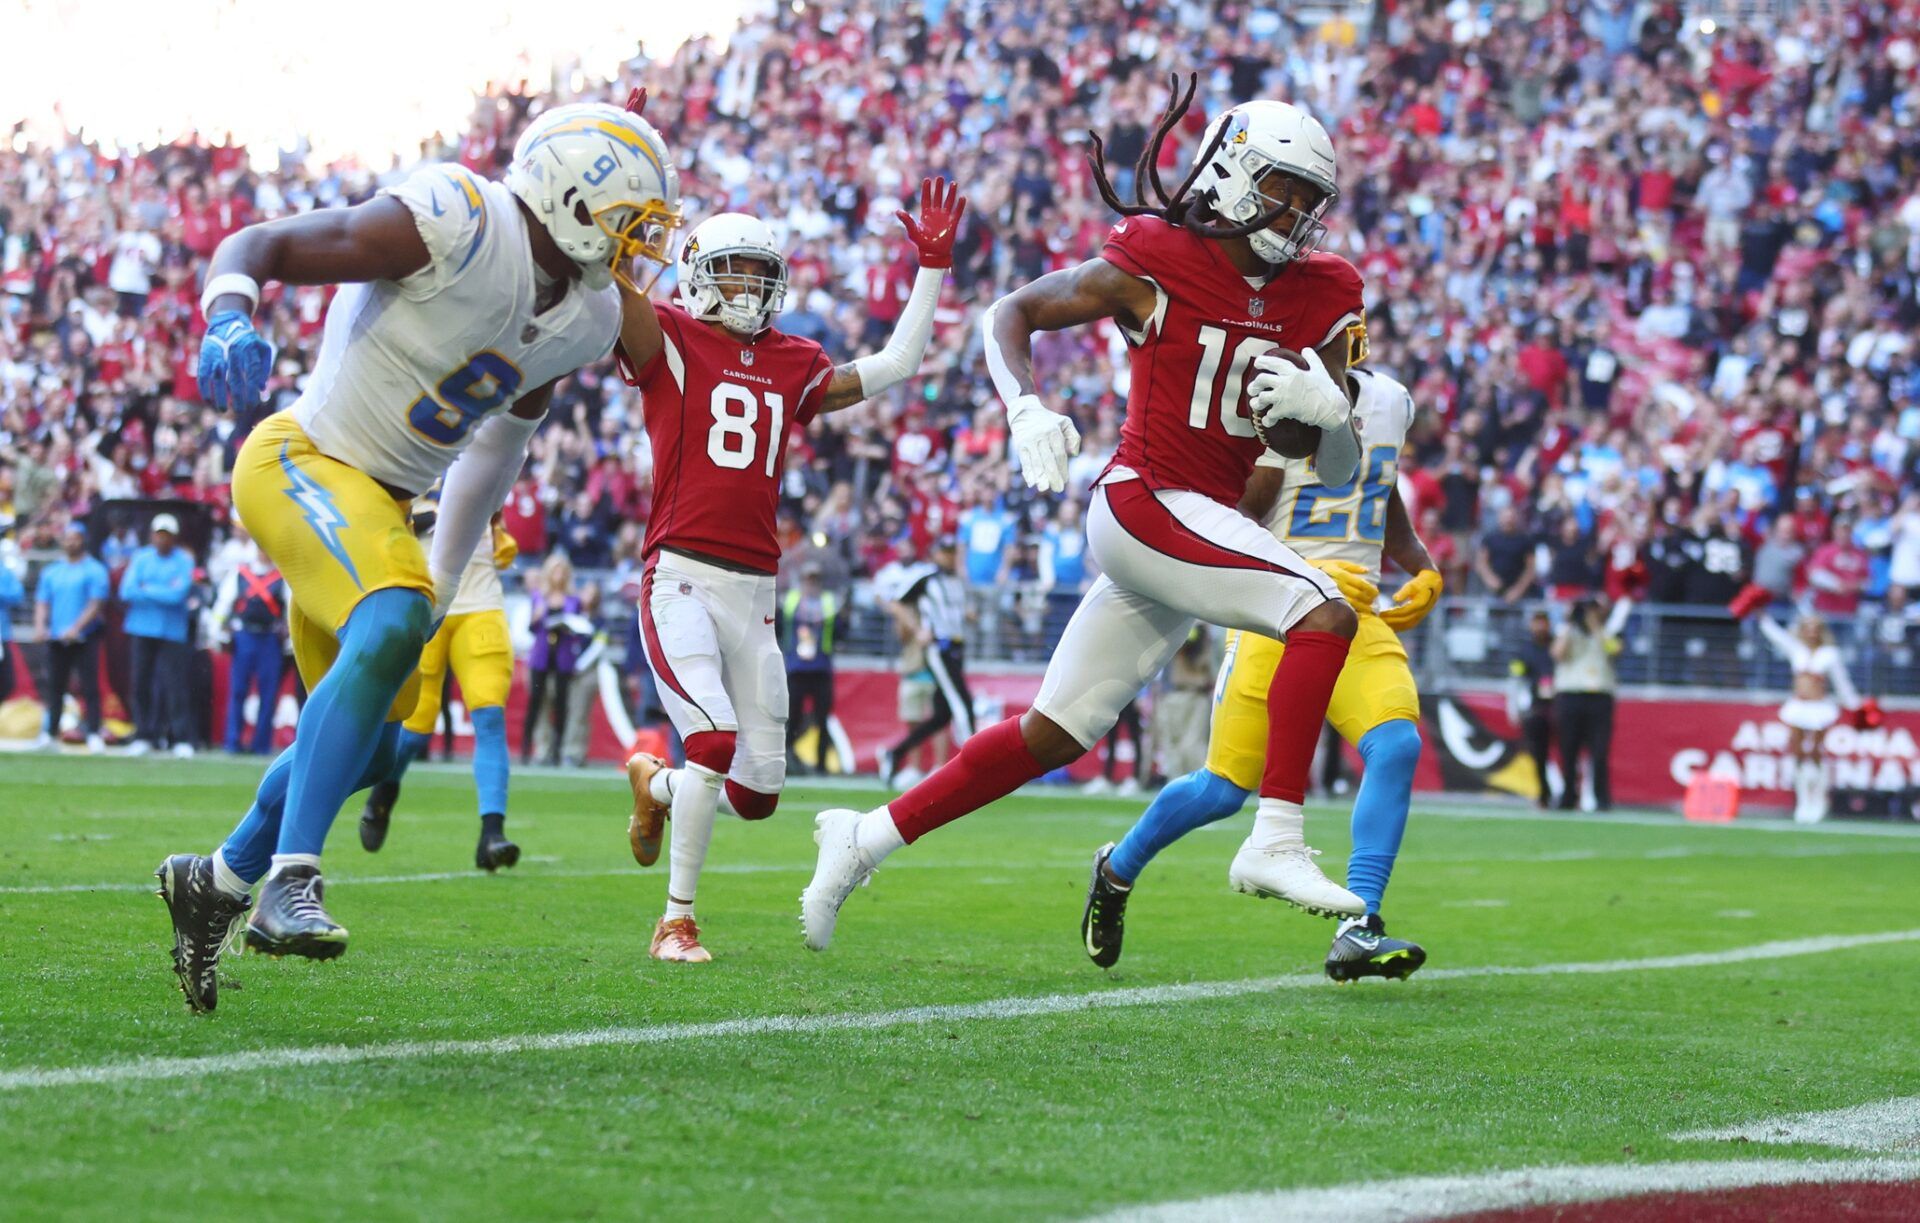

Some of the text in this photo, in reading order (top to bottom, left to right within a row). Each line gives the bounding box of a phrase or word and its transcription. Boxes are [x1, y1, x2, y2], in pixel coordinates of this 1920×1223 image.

[583, 154, 616, 186] 9
[405, 348, 525, 449] 9
[723, 369, 773, 385] CARDINALS
[1189, 325, 1279, 438] 10
[707, 382, 783, 477] 81
[1731, 720, 1916, 759] ARONA
